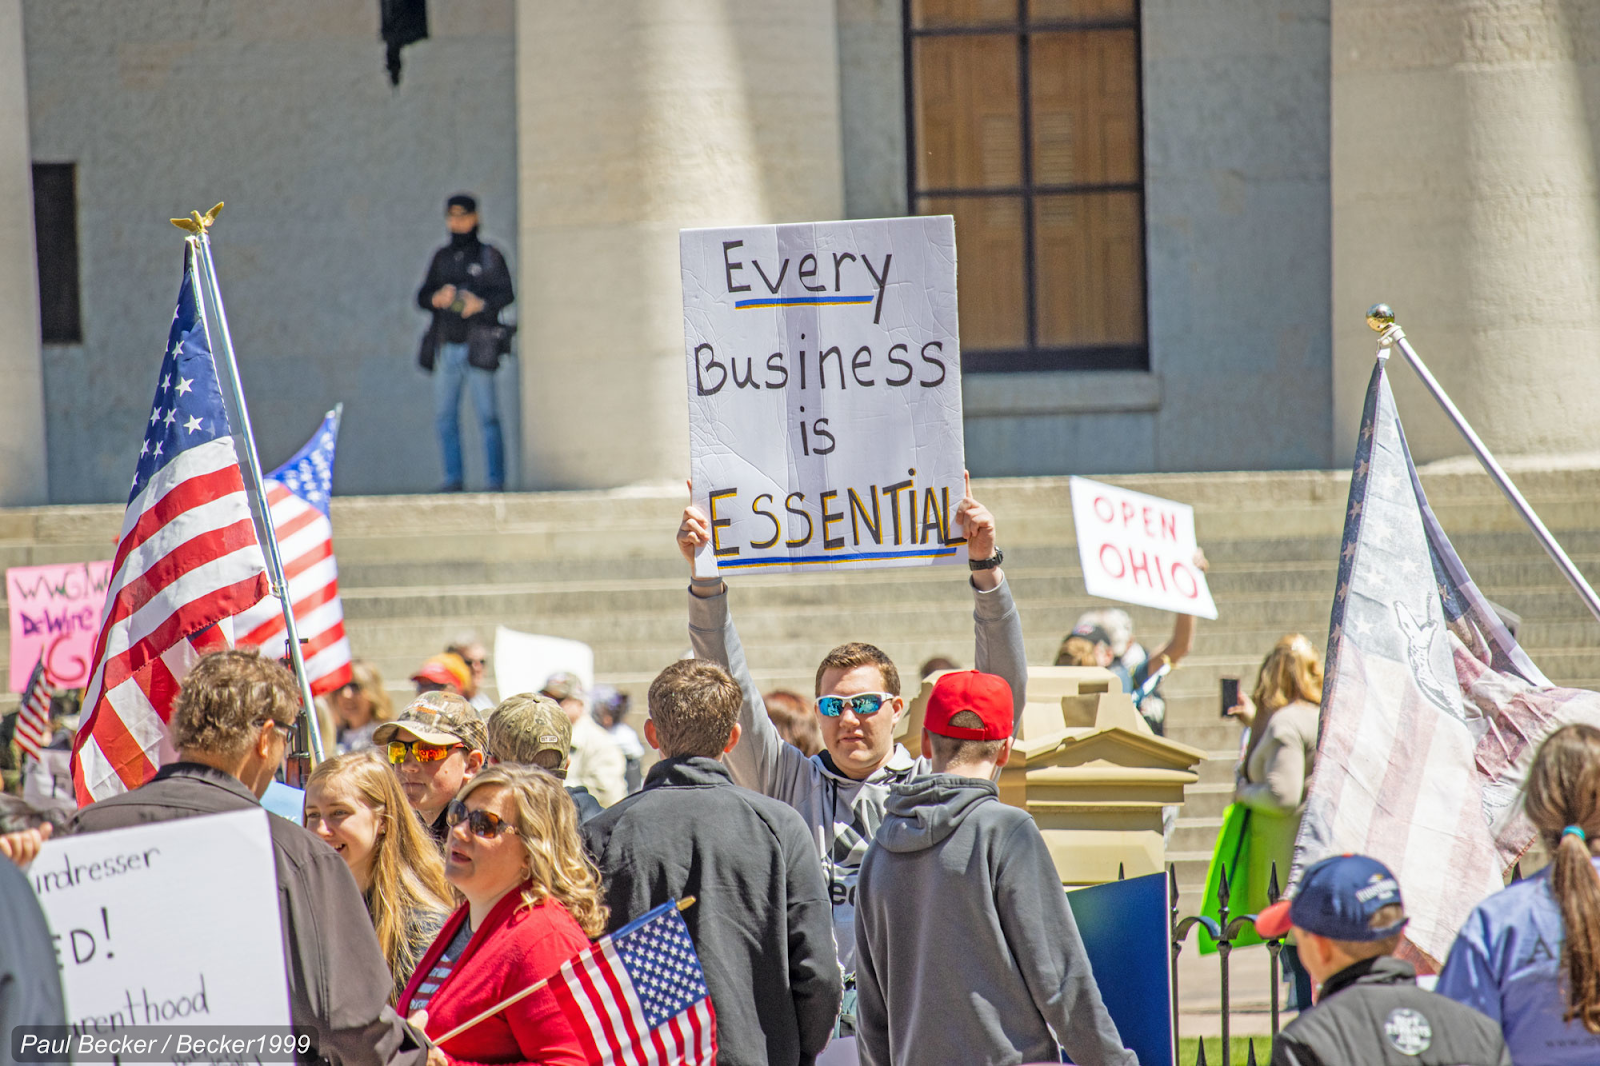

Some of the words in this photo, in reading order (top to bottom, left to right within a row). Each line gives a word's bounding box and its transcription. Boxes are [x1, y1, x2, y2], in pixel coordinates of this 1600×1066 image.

[722, 239, 892, 325] Every
[694, 333, 947, 397] Business
[799, 405, 836, 456] is
[1093, 496, 1177, 542] OPEN
[1099, 543, 1198, 599] OHIO
